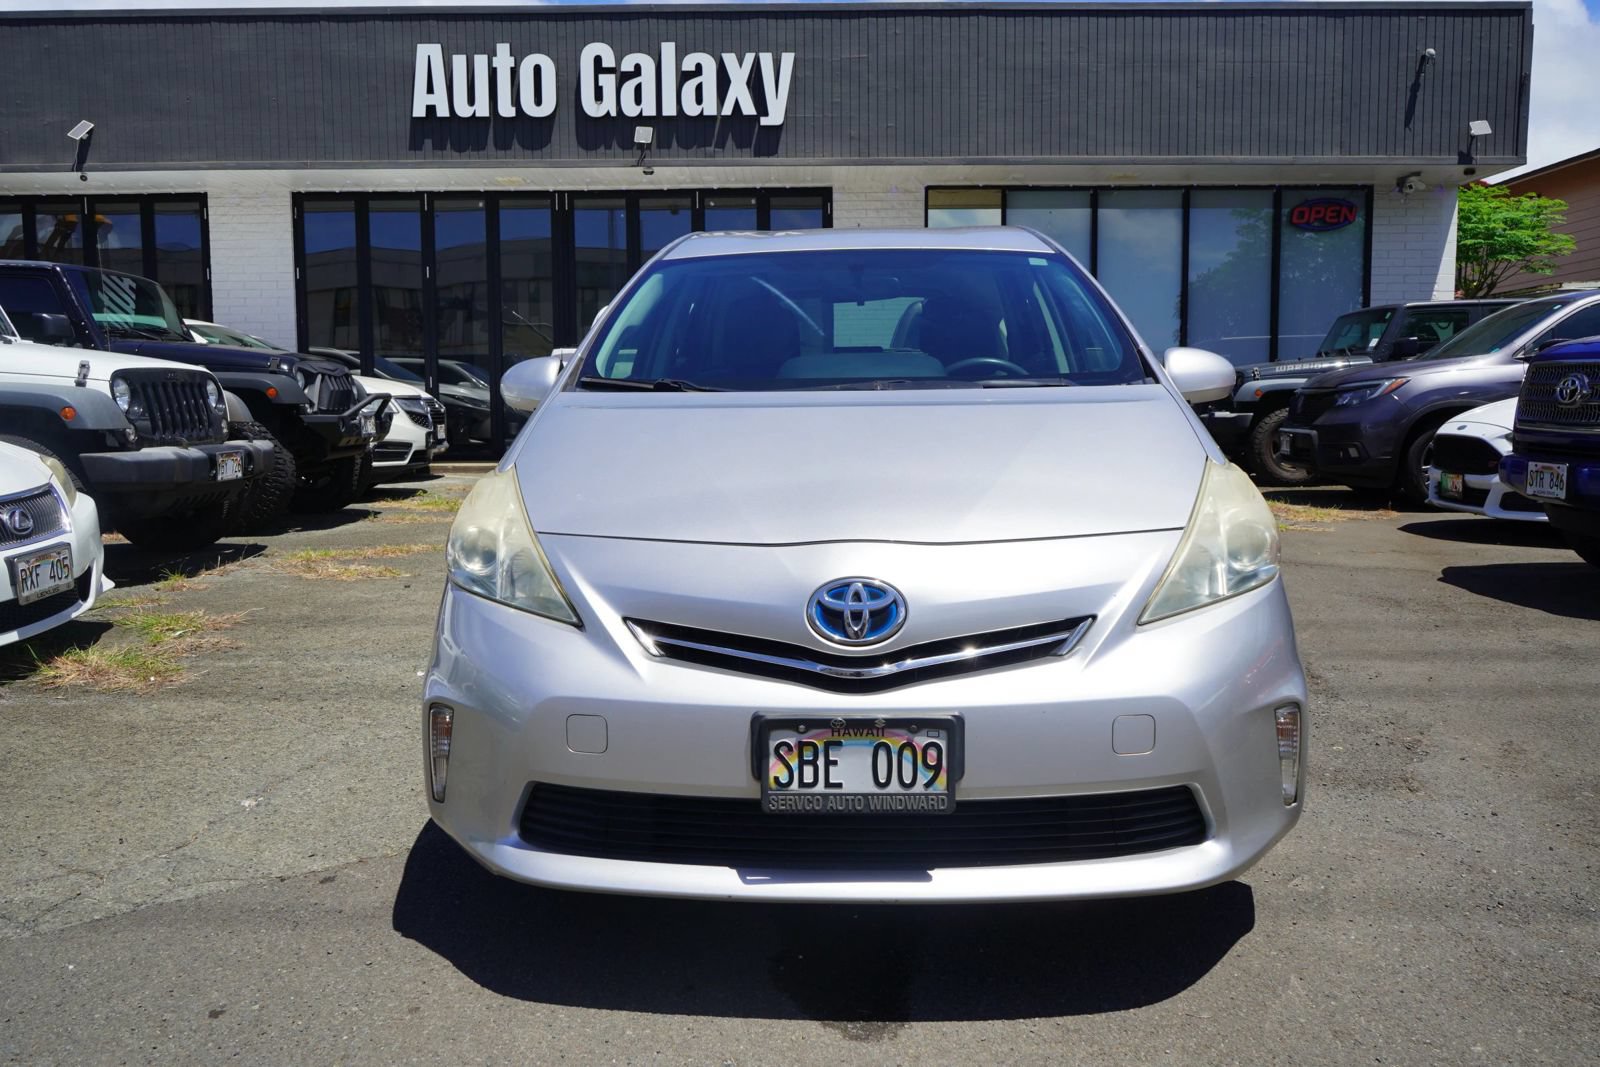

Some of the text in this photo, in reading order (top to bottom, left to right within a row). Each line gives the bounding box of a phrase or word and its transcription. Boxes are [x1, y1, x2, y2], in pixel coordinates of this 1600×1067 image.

[412, 41, 796, 127] Auto Galaxy
[1291, 205, 1359, 225] OPEN
[1529, 470, 1565, 491] STR 846
[20, 556, 70, 593] RXF 405
[831, 727, 885, 738] HAWAII
[773, 740, 944, 789] SBE 009
[769, 795, 948, 811] SERVCO AUTO WINDWARD
